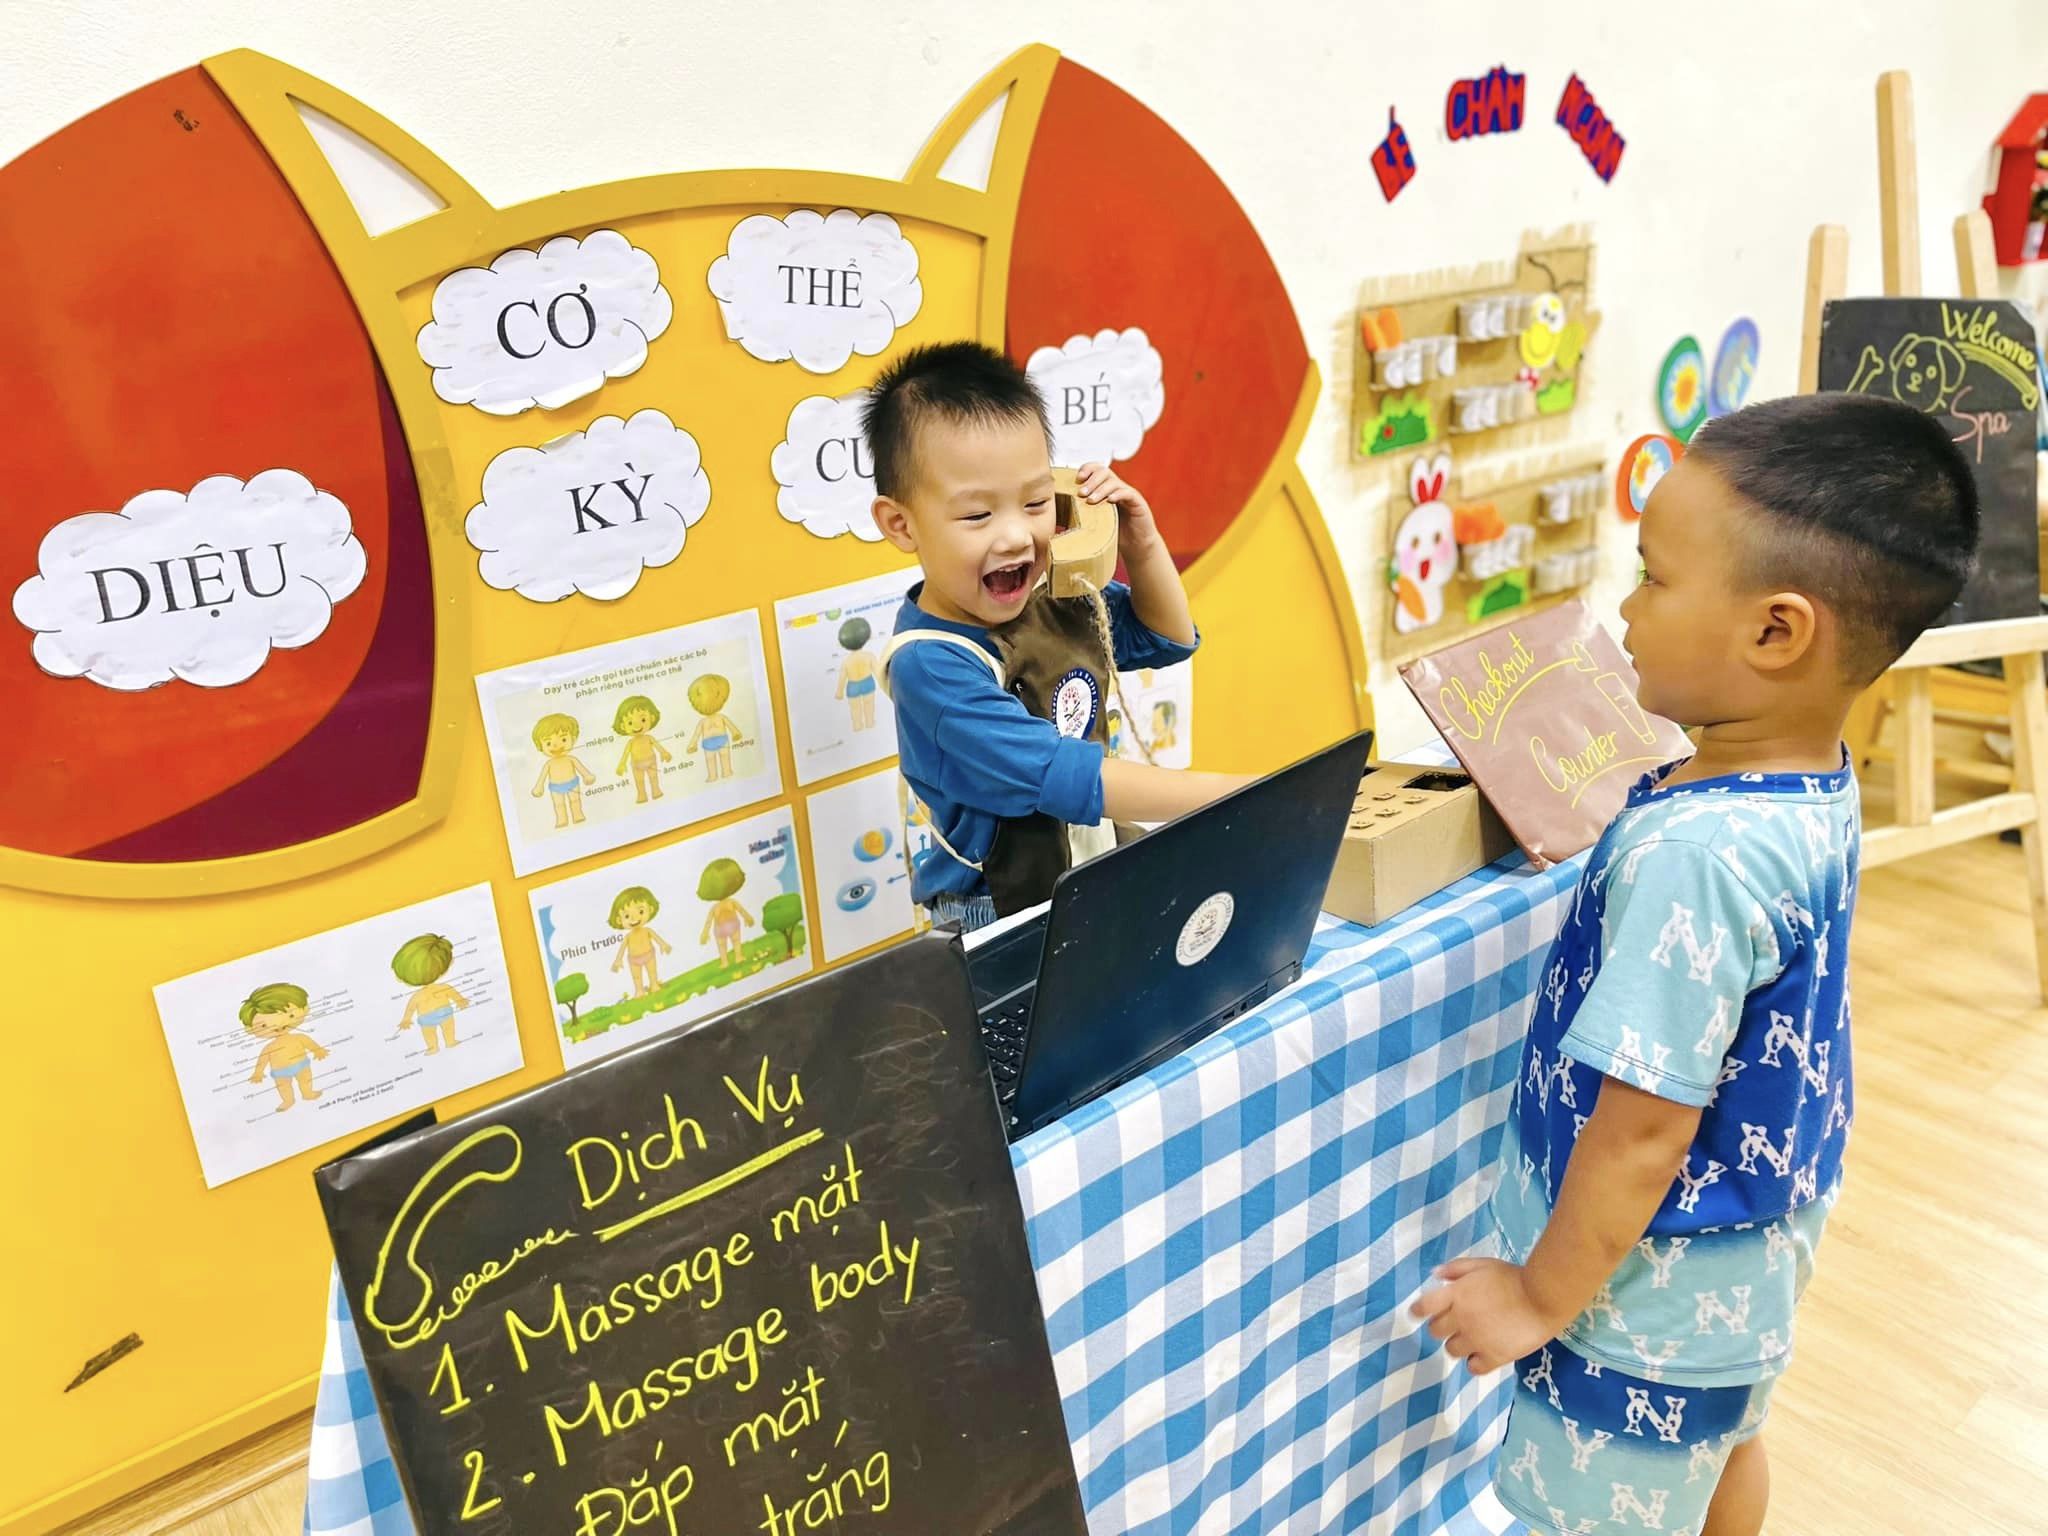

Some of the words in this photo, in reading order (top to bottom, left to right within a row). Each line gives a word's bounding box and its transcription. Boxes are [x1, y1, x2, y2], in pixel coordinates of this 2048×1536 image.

[1555, 71, 1626, 186] NGOAN
[496, 283, 597, 360] CƠ
[777, 257, 864, 309] THỂ
[1940, 301, 2038, 372] Welcome
[566, 462, 655, 534] KỲ
[1061, 372, 1112, 426] BÉ
[1951, 386, 2013, 464] Spa
[86, 543, 288, 623] DIỆU
[1439, 631, 1535, 740] Checkout
[1530, 725, 1617, 792] Counter
[566, 1093, 707, 1210] Dịch
[722, 1056, 804, 1129] Vụ
[505, 1231, 754, 1372] Massage
[771, 1142, 863, 1240] mặt
[543, 1305, 788, 1466] Massage
[809, 1219, 921, 1313] body
[723, 1366, 825, 1465] mặt
[758, 1420, 891, 1536] trắng
